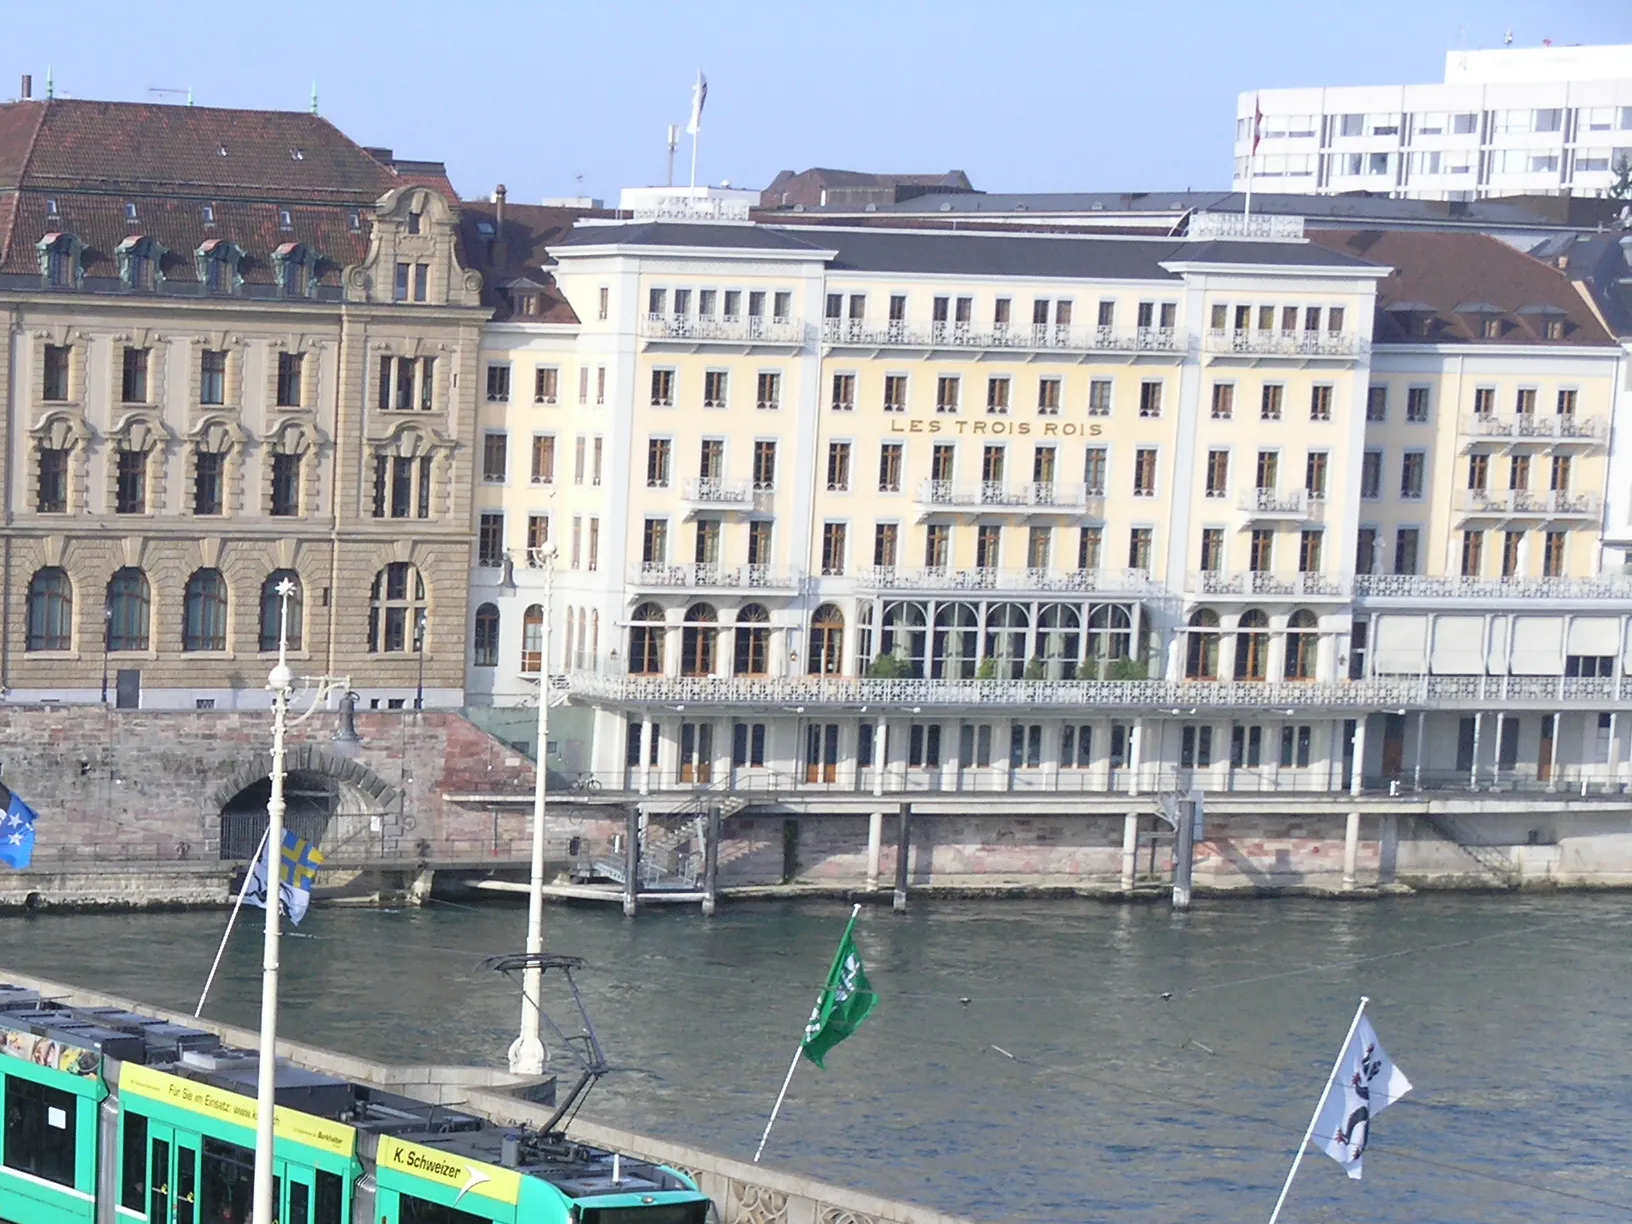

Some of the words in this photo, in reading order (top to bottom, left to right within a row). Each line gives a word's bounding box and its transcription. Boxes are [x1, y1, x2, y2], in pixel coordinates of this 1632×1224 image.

[890, 419, 942, 433] LES
[954, 420, 1031, 435] TROIS
[1043, 422, 1103, 436] ROIS
[168, 1083, 181, 1097] Für
[181, 1087, 193, 1101] Sie
[194, 1092, 204, 1104] im
[393, 1146, 405, 1164] K.
[406, 1150, 462, 1180] Schweizer
